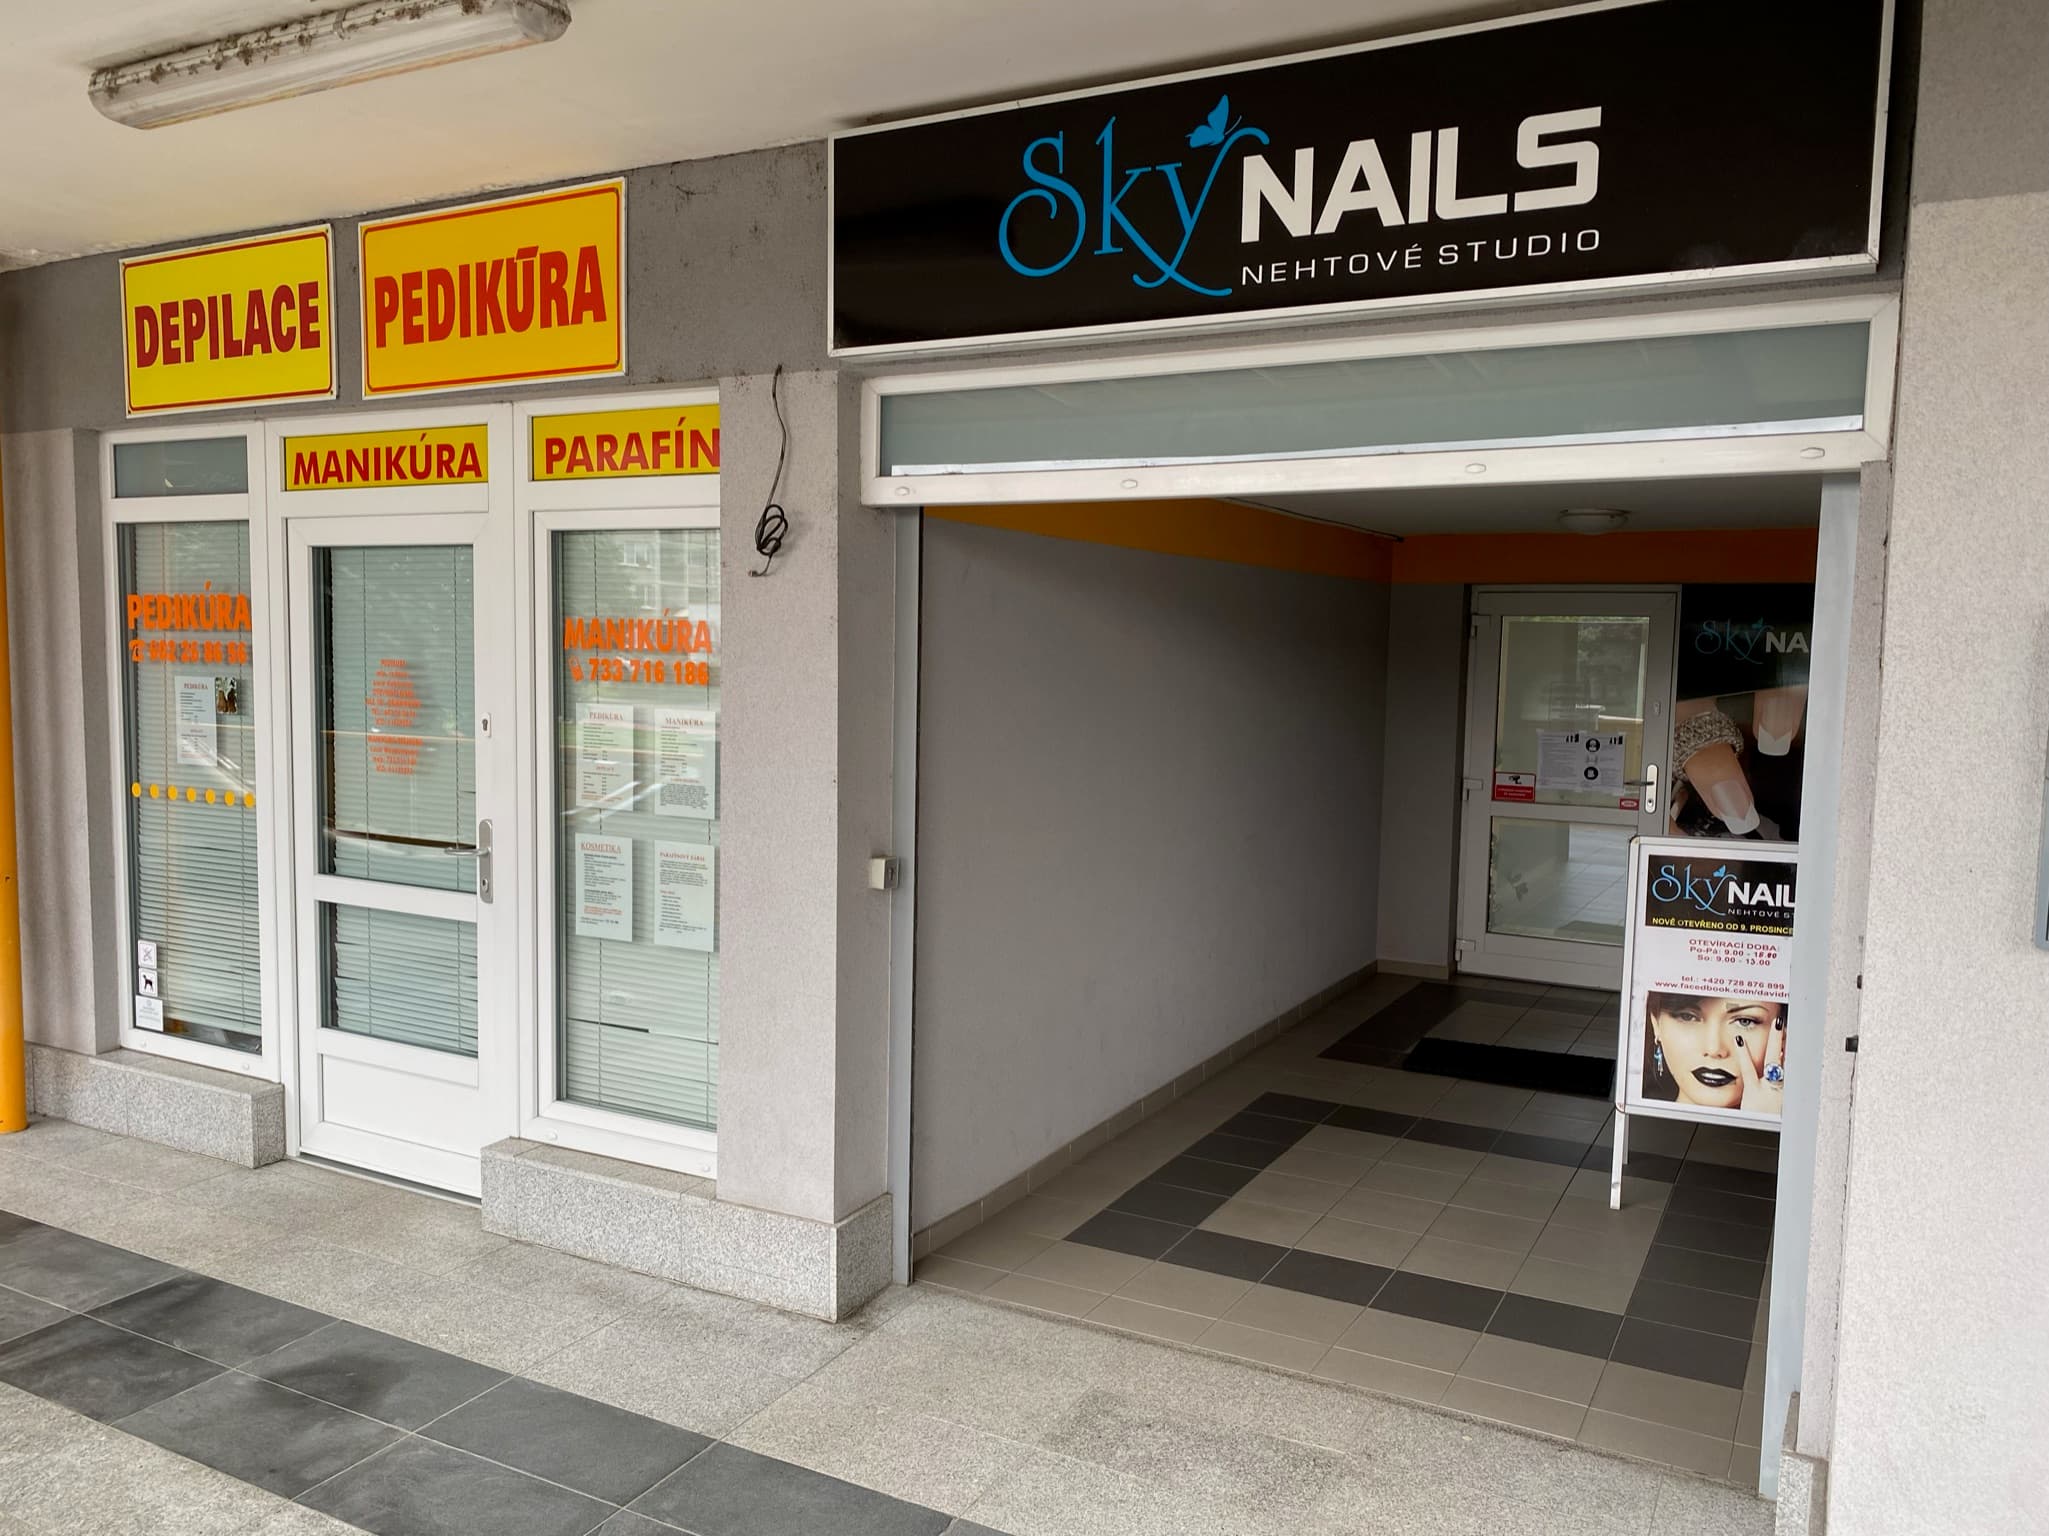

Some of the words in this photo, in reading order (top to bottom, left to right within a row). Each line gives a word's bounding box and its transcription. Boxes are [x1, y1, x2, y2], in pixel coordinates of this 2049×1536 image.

[999, 116, 1269, 296] Sky
[1241, 106, 1601, 243] NAILS
[1241, 243, 1423, 285] NEHTOVÉ
[1439, 228, 1600, 265] STUDIO
[135, 281, 321, 368] DEPILACE
[293, 434, 482, 486] MANIKÚRA
[545, 416, 721, 475] PARAFÍN
[127, 580, 253, 631] PEDIKÚRA
[564, 608, 713, 654] MANIKÚRA
[588, 657, 624, 683] 733
[629, 659, 666, 684] 716
[1652, 863, 1737, 916] Sky
[1726, 922, 1739, 931] OD
[1702, 977, 1725, 985] +420
